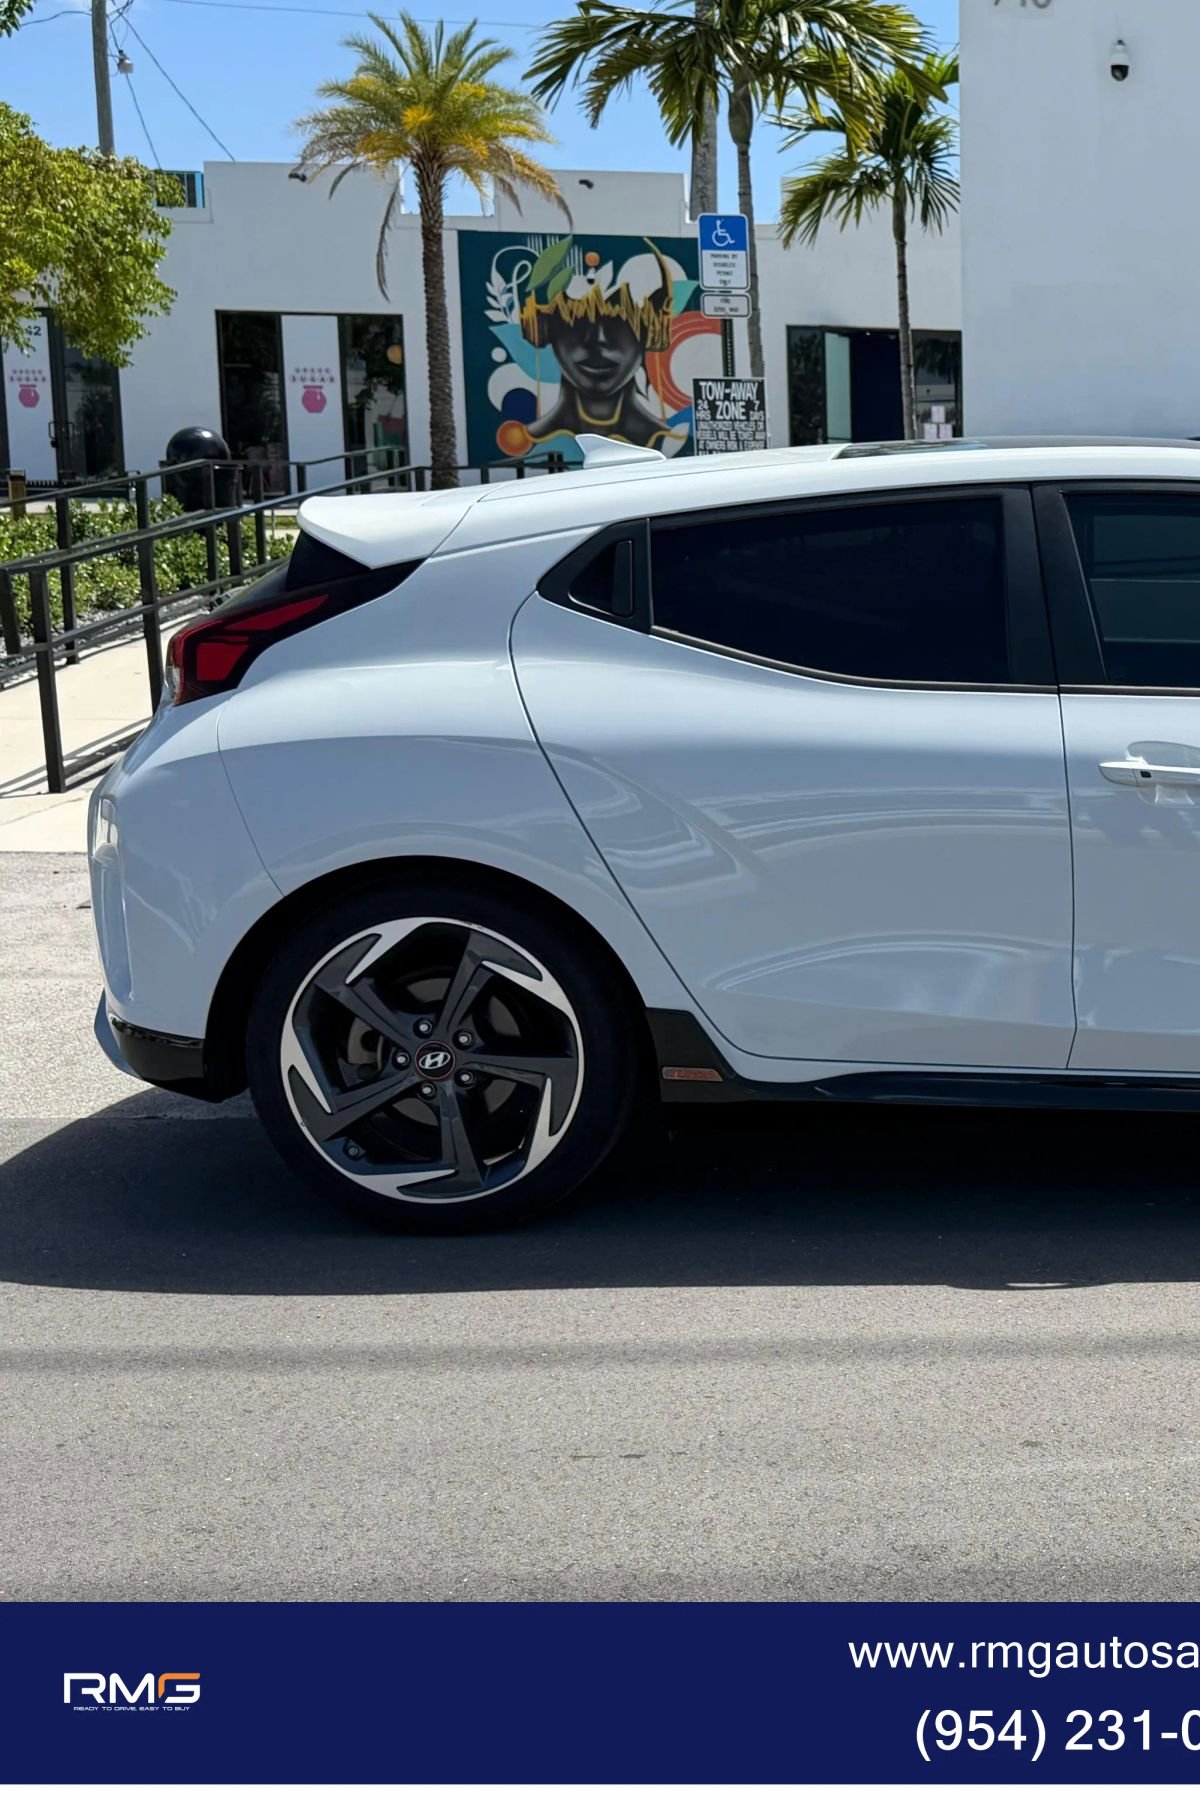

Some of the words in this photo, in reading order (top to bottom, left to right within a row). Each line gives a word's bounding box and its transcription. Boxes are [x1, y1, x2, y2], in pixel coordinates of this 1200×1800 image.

[699, 381, 758, 400] TOW-AWAY
[697, 399, 709, 410] 24
[753, 400, 760, 411] 7
[696, 410, 711, 420] HRS
[715, 401, 747, 420] ZONE
[749, 410, 764, 421] DAYS
